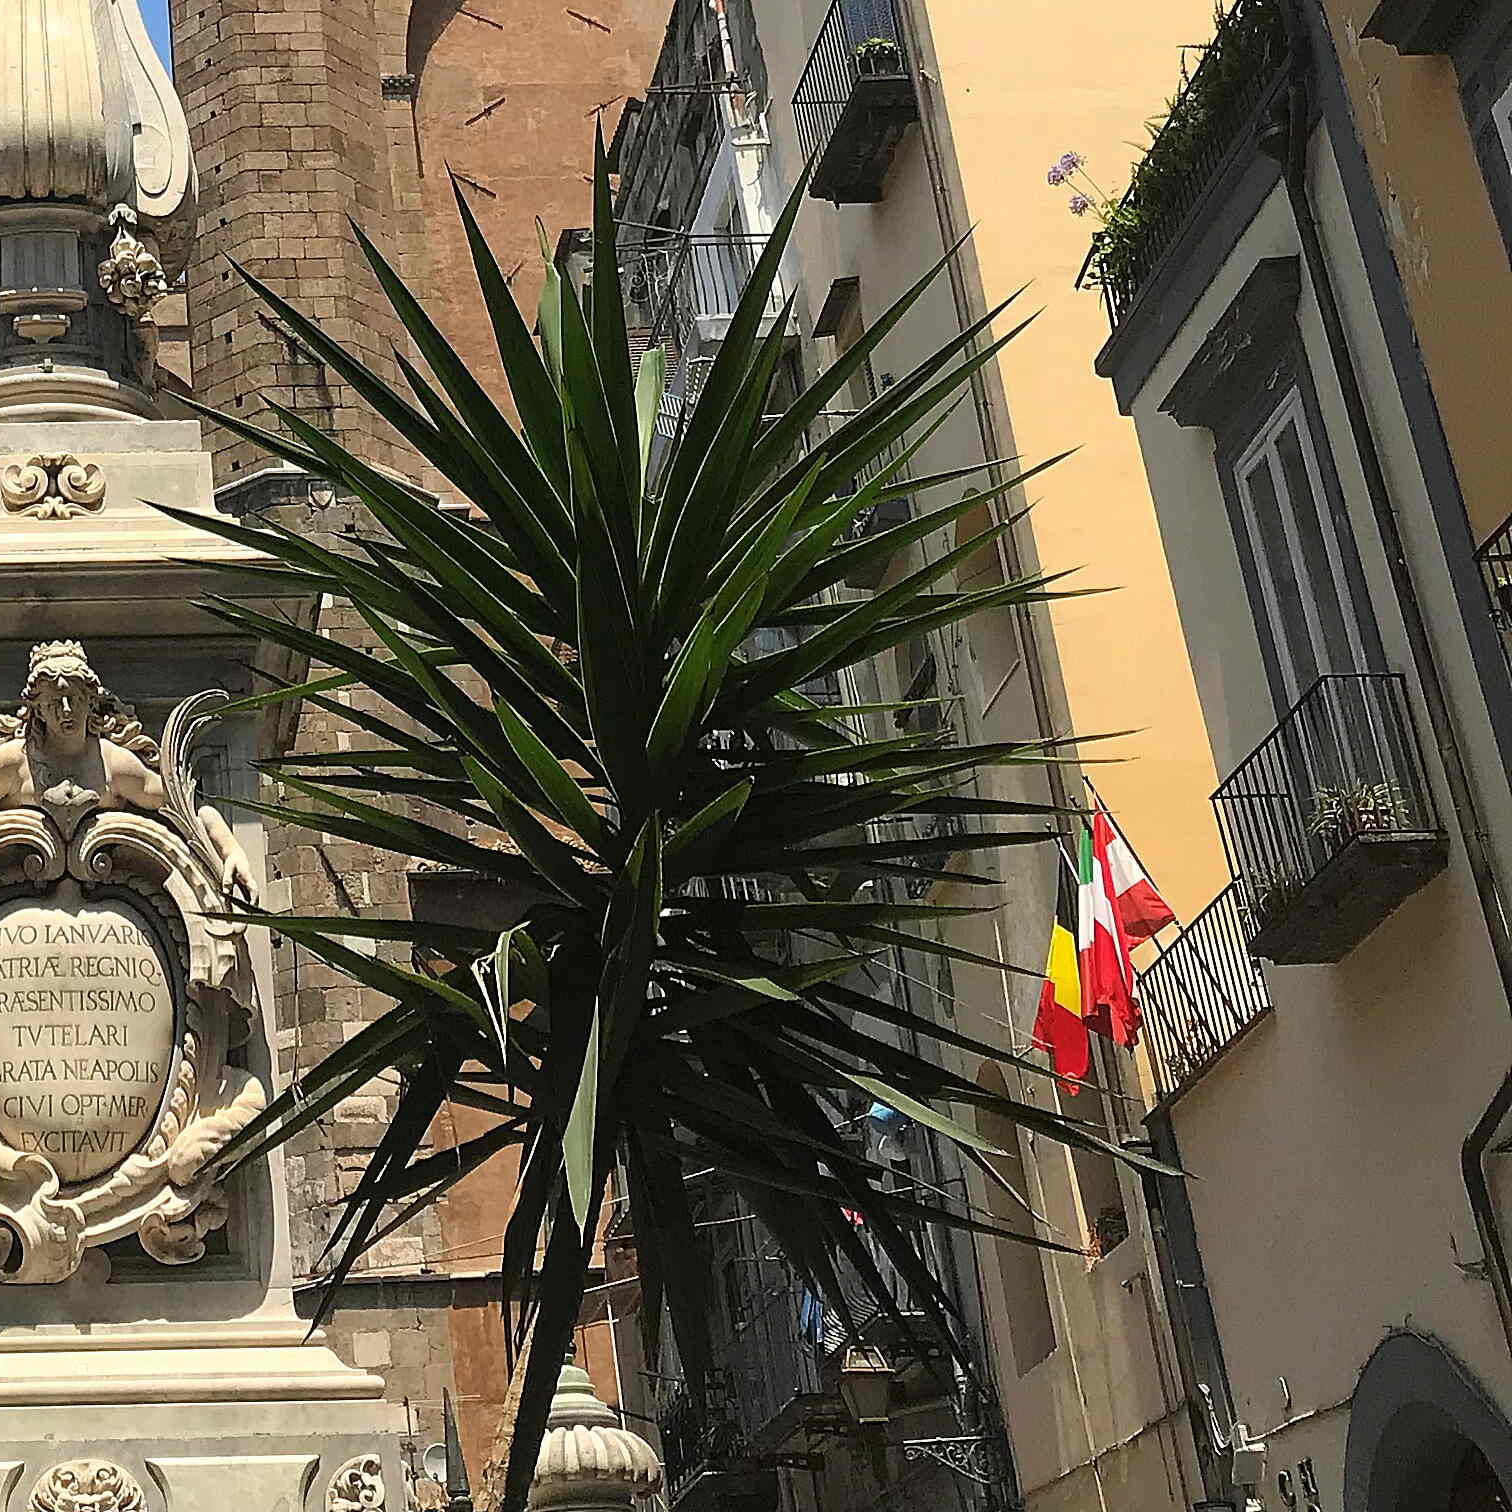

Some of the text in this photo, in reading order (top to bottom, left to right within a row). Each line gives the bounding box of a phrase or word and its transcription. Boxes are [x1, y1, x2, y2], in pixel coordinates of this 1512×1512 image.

[12, 1024, 128, 1047] TVTELARI
[63, 1059, 159, 1083] NEAPOLIS
[3, 1095, 53, 1119] CIVI
[21, 1130, 128, 1154] EXCITAVIT
